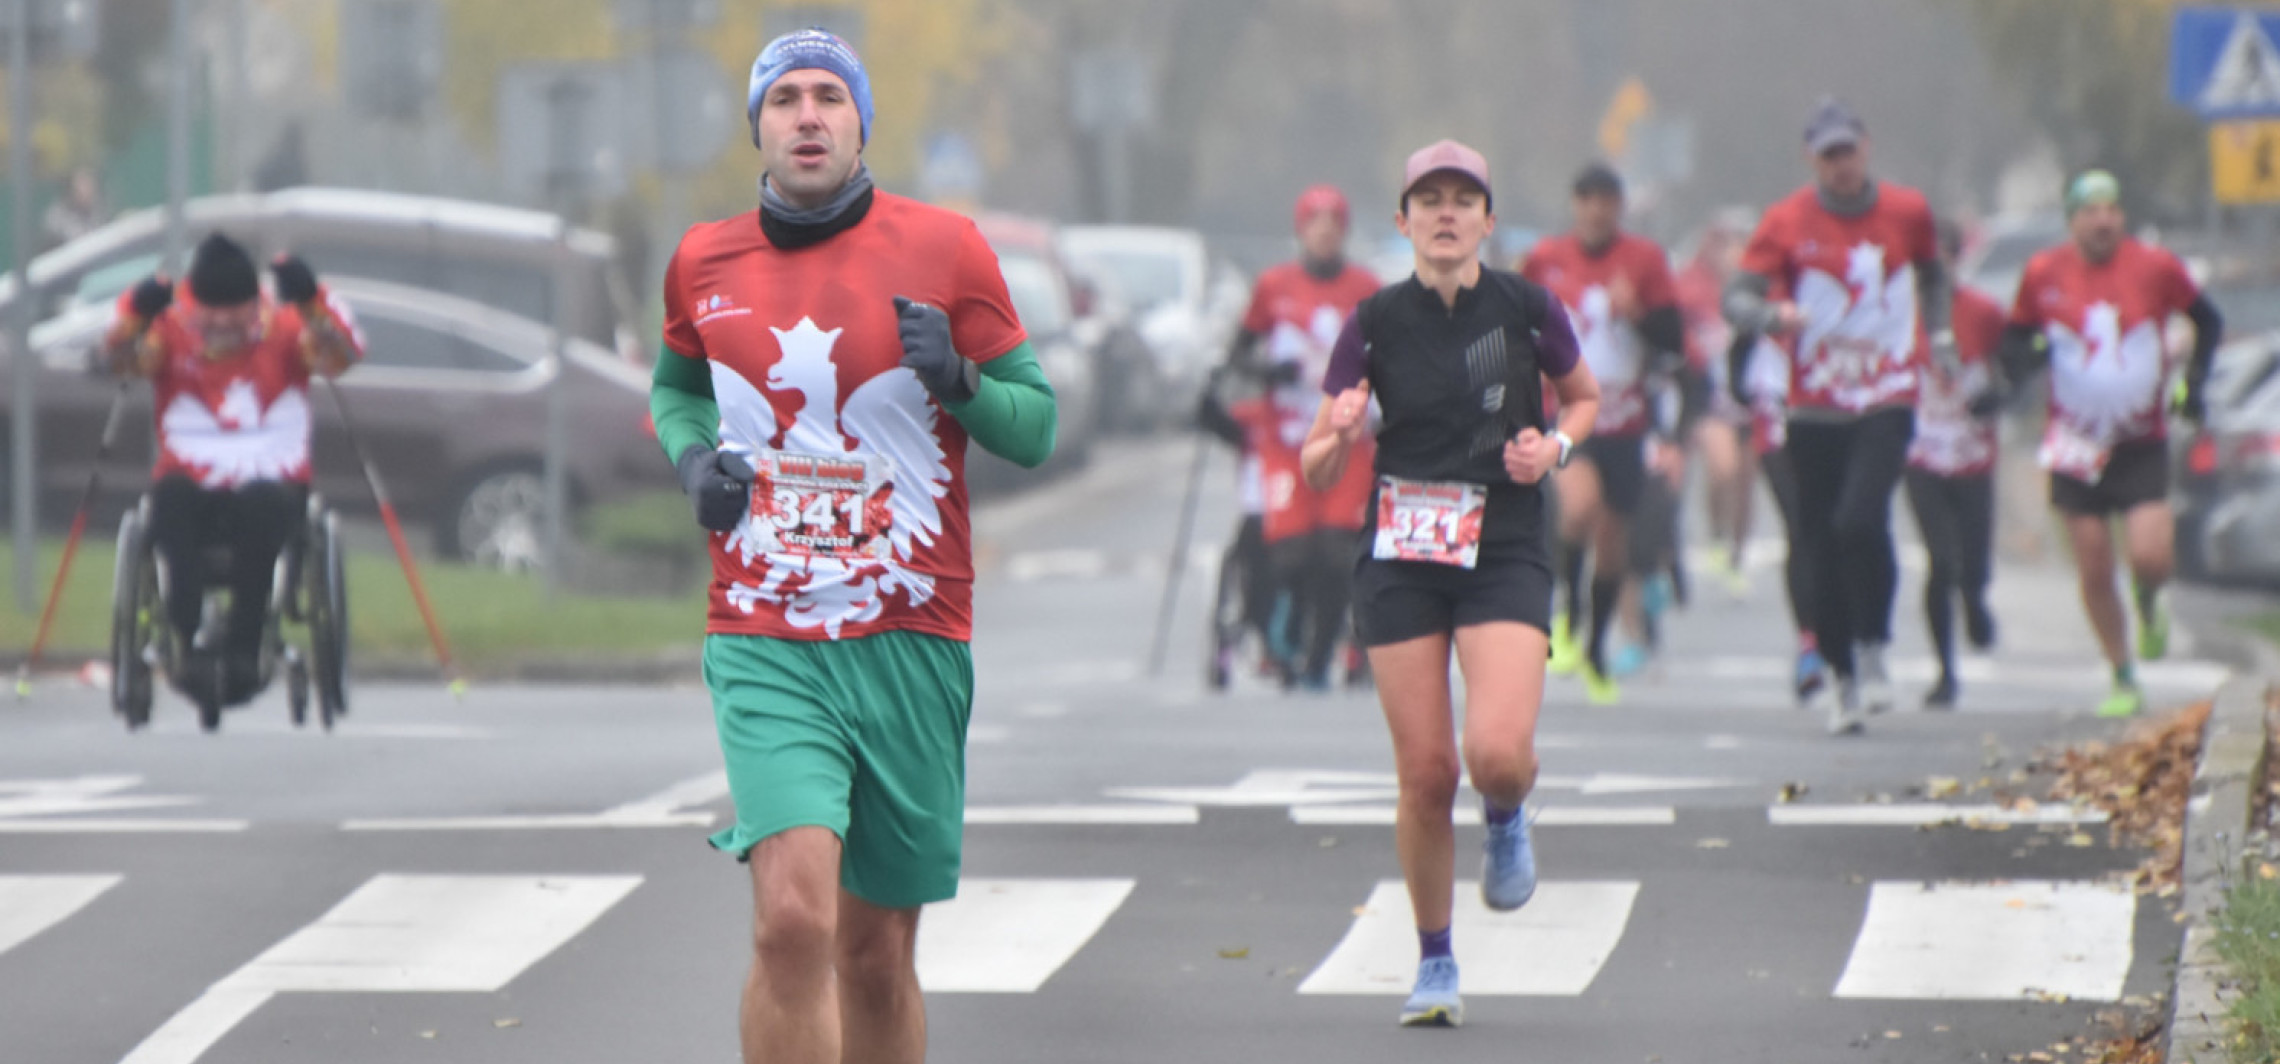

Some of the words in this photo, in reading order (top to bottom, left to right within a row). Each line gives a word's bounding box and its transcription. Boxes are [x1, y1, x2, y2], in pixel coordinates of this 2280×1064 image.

[771, 490, 864, 533] 341
[1395, 508, 1459, 544] 321
[784, 532, 855, 549] Krzysztof
